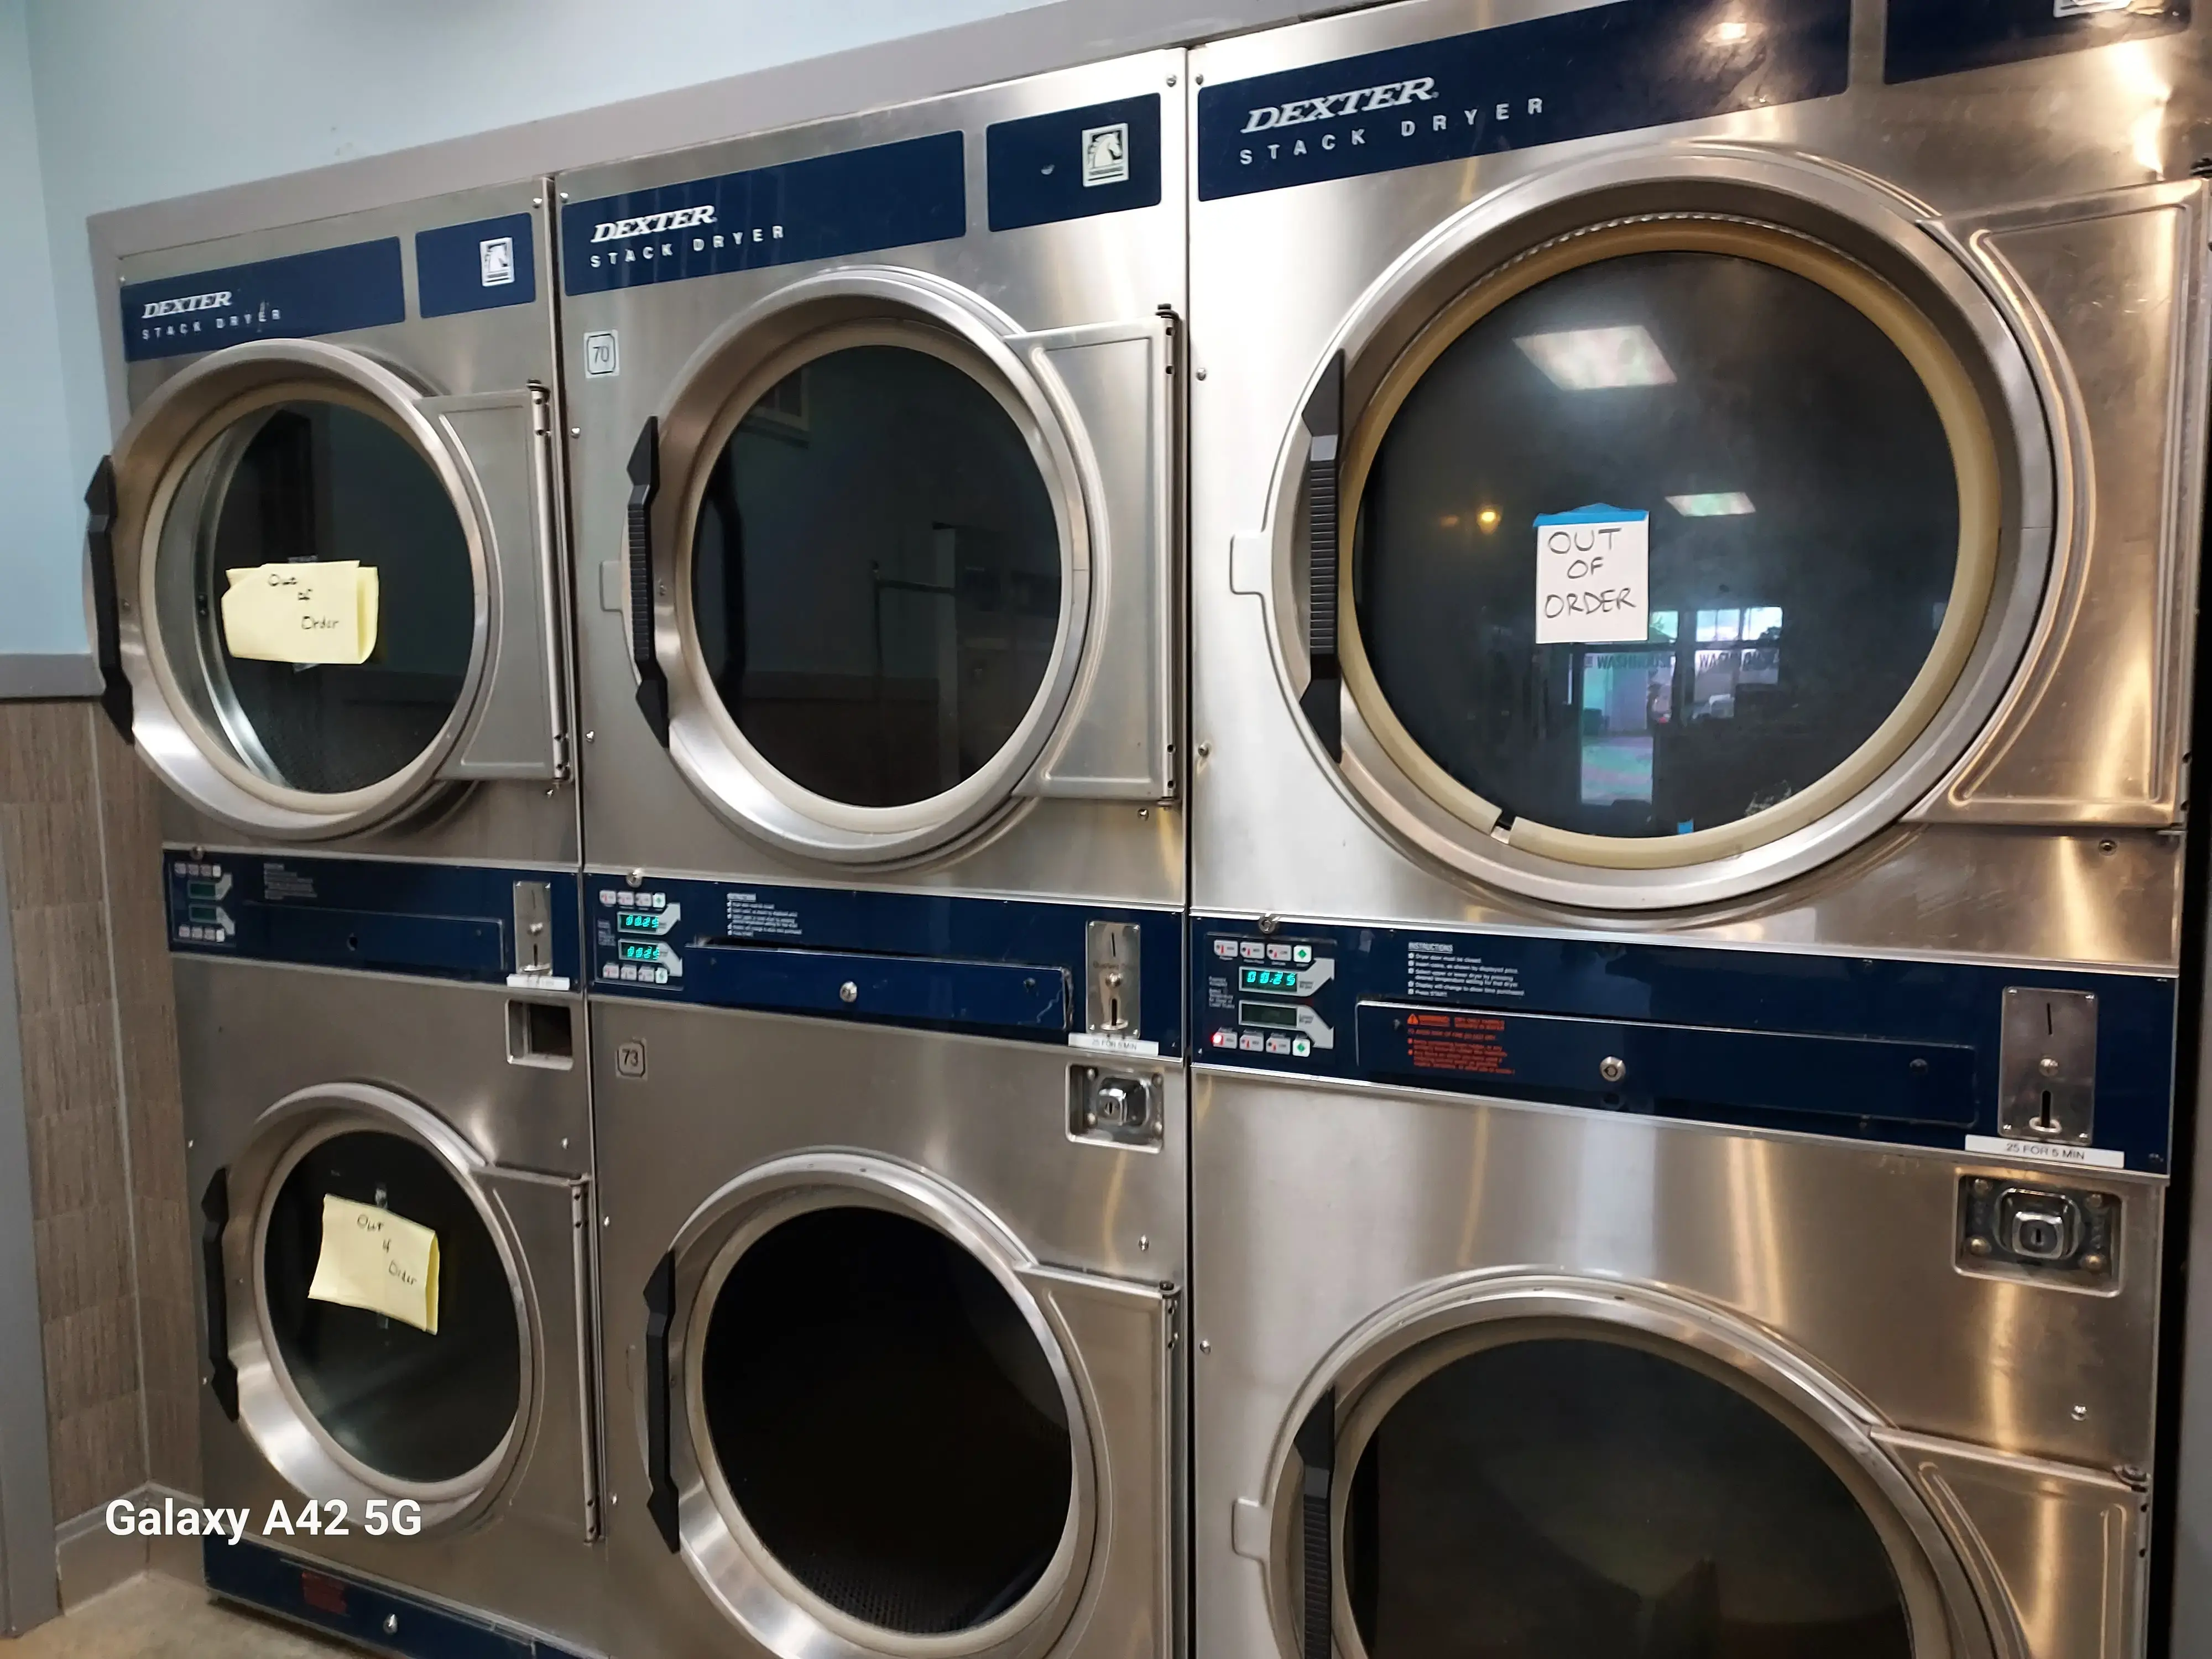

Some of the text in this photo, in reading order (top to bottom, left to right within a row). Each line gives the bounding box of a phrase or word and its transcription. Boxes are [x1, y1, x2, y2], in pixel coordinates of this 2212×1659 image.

[1240, 76, 1436, 134] DEXTER
[1239, 97, 1544, 165] STACK DRYER
[590, 205, 716, 243] DEXTER
[590, 225, 784, 269] STACK DRYER
[142, 291, 233, 319] DEXTER
[142, 309, 282, 340] STACK DRYER
[593, 346, 609, 364] 70
[1548, 528, 1621, 554] OUT
[1567, 556, 1604, 579] OF
[1545, 587, 1636, 618] ORDER
[301, 616, 340, 630] Order
[622, 1048, 638, 1067] 73
[2006, 1142, 2085, 1160] 25 FOR 5 MIN
[357, 1214, 385, 1232] Out
